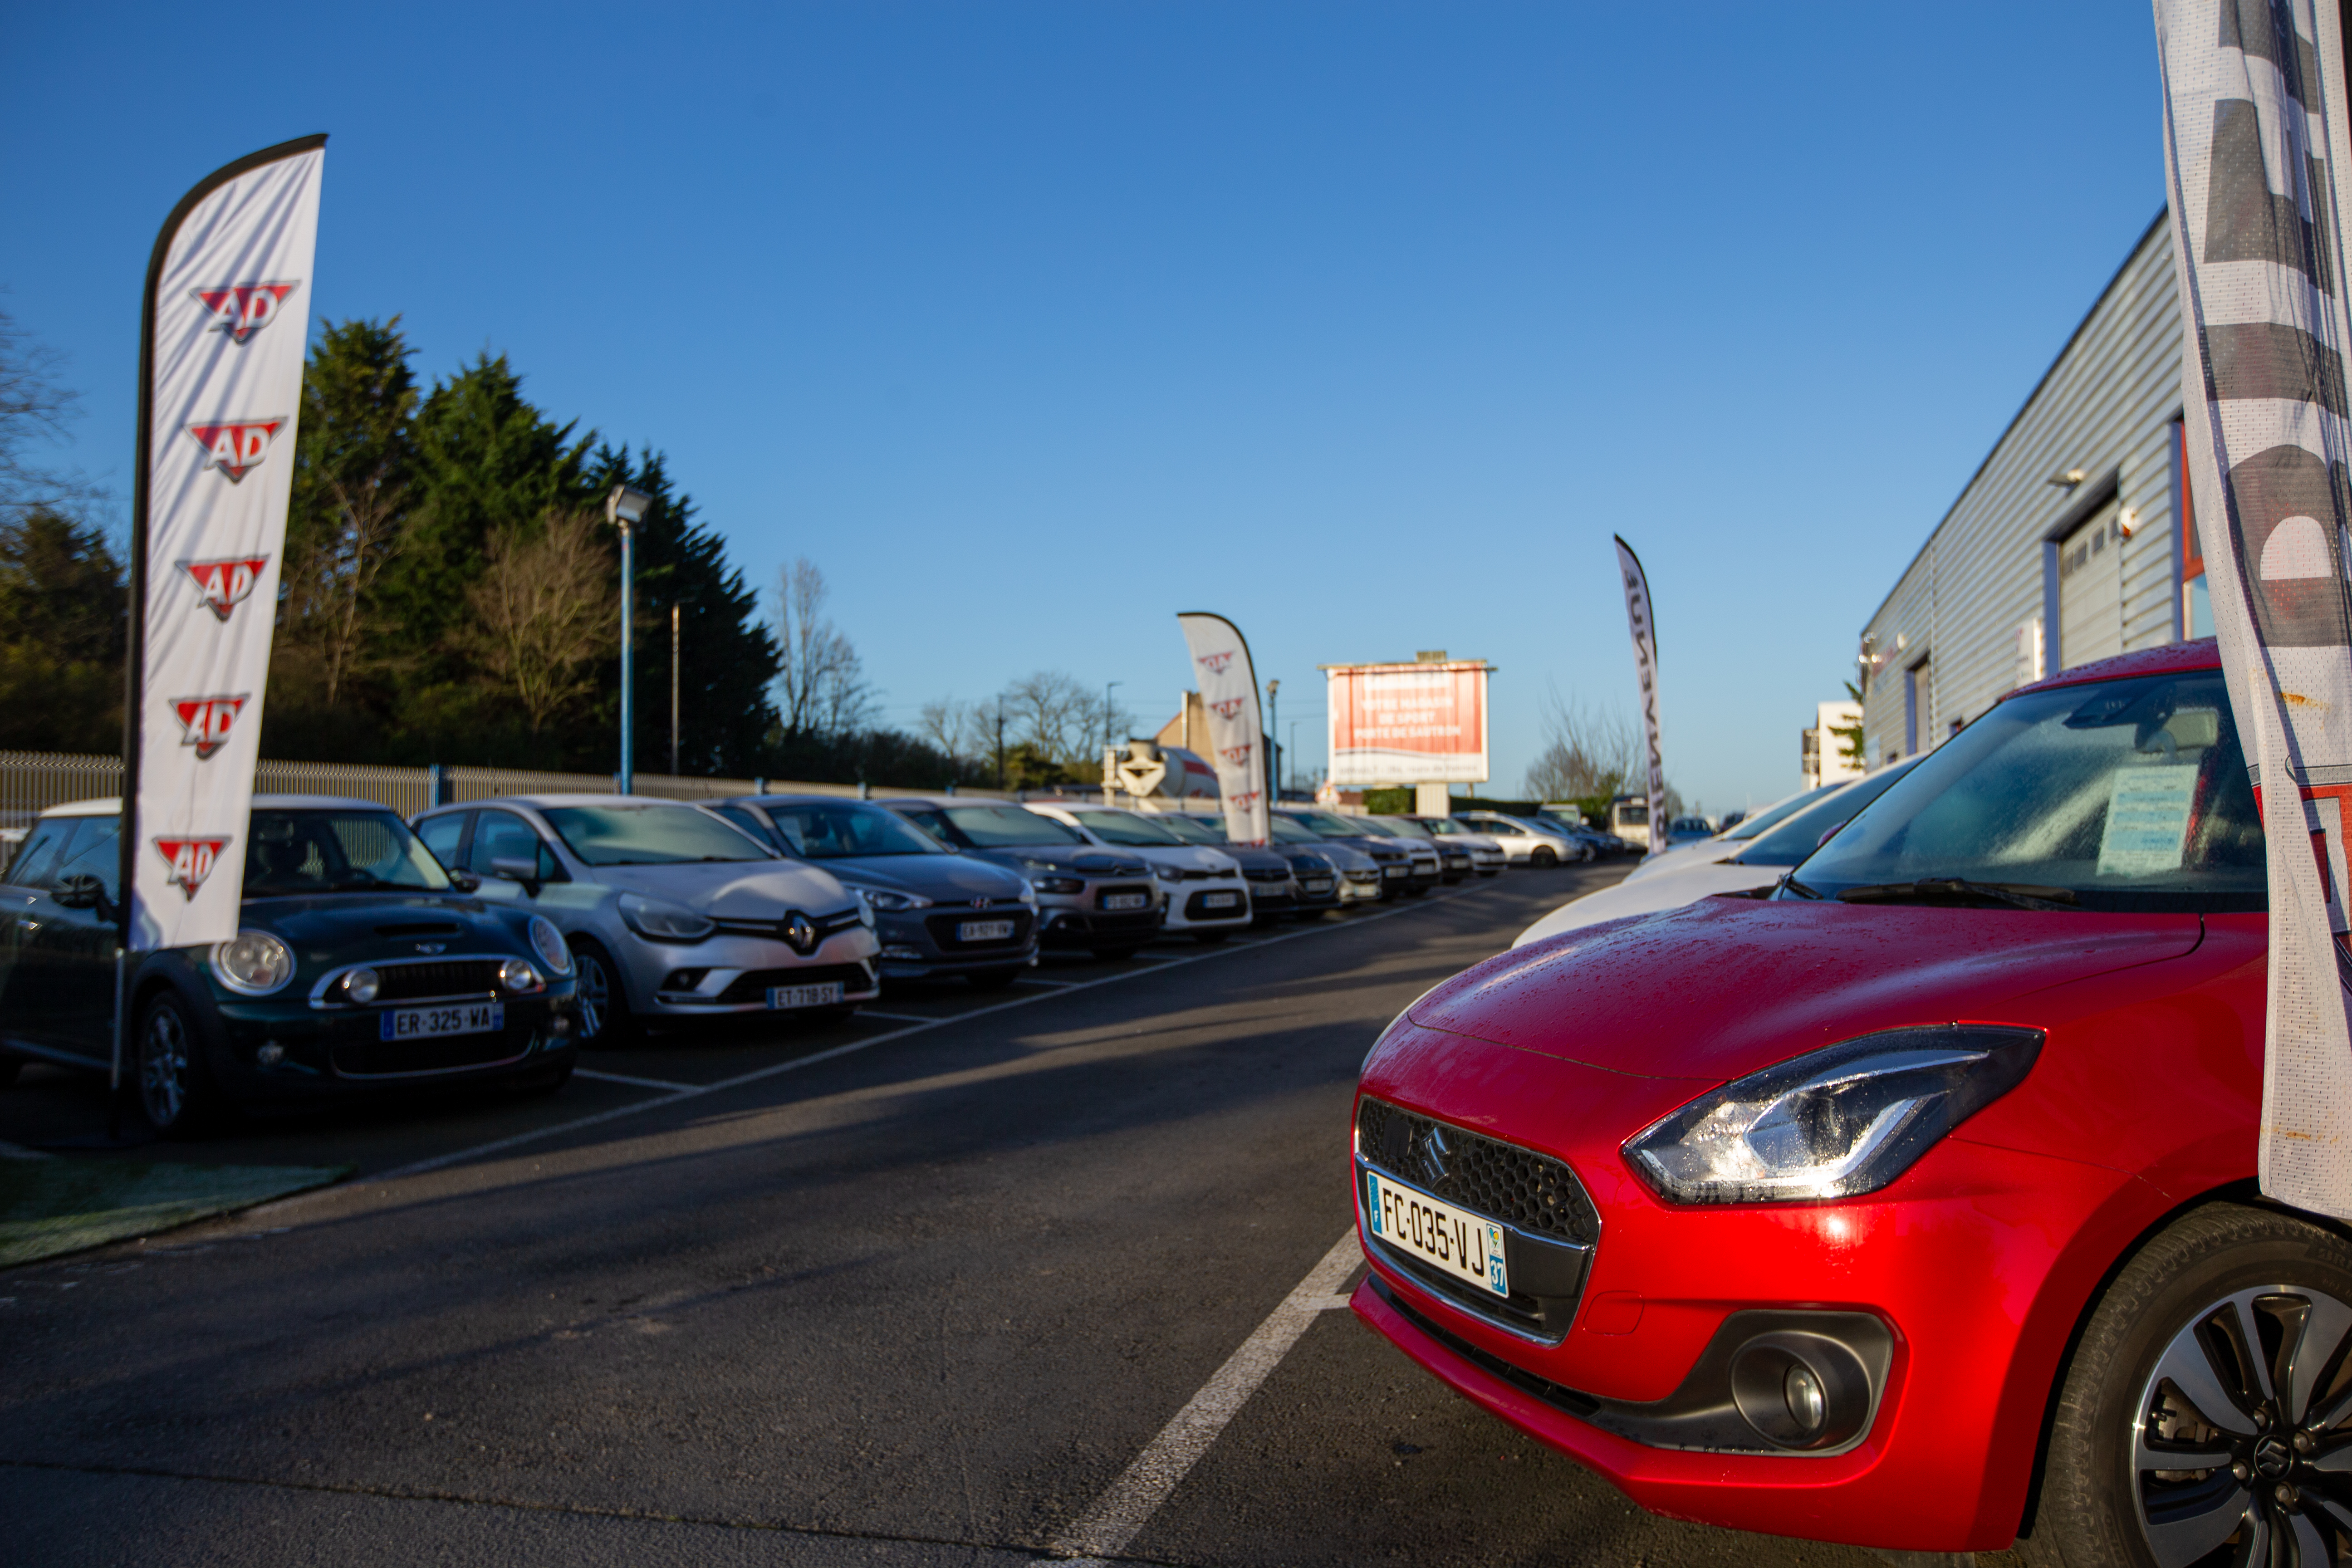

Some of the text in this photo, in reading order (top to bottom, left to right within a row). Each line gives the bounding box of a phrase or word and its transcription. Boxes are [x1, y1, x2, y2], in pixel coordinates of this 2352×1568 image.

[209, 287, 279, 333] AD
[204, 427, 270, 470] AD
[198, 564, 254, 608] AD
[181, 702, 236, 746] AD
[1397, 711, 1435, 724] SPORT
[168, 843, 215, 884] AD
[1382, 1187, 1485, 1277] FC-035-VJ
[1490, 1259, 1504, 1287] 37
